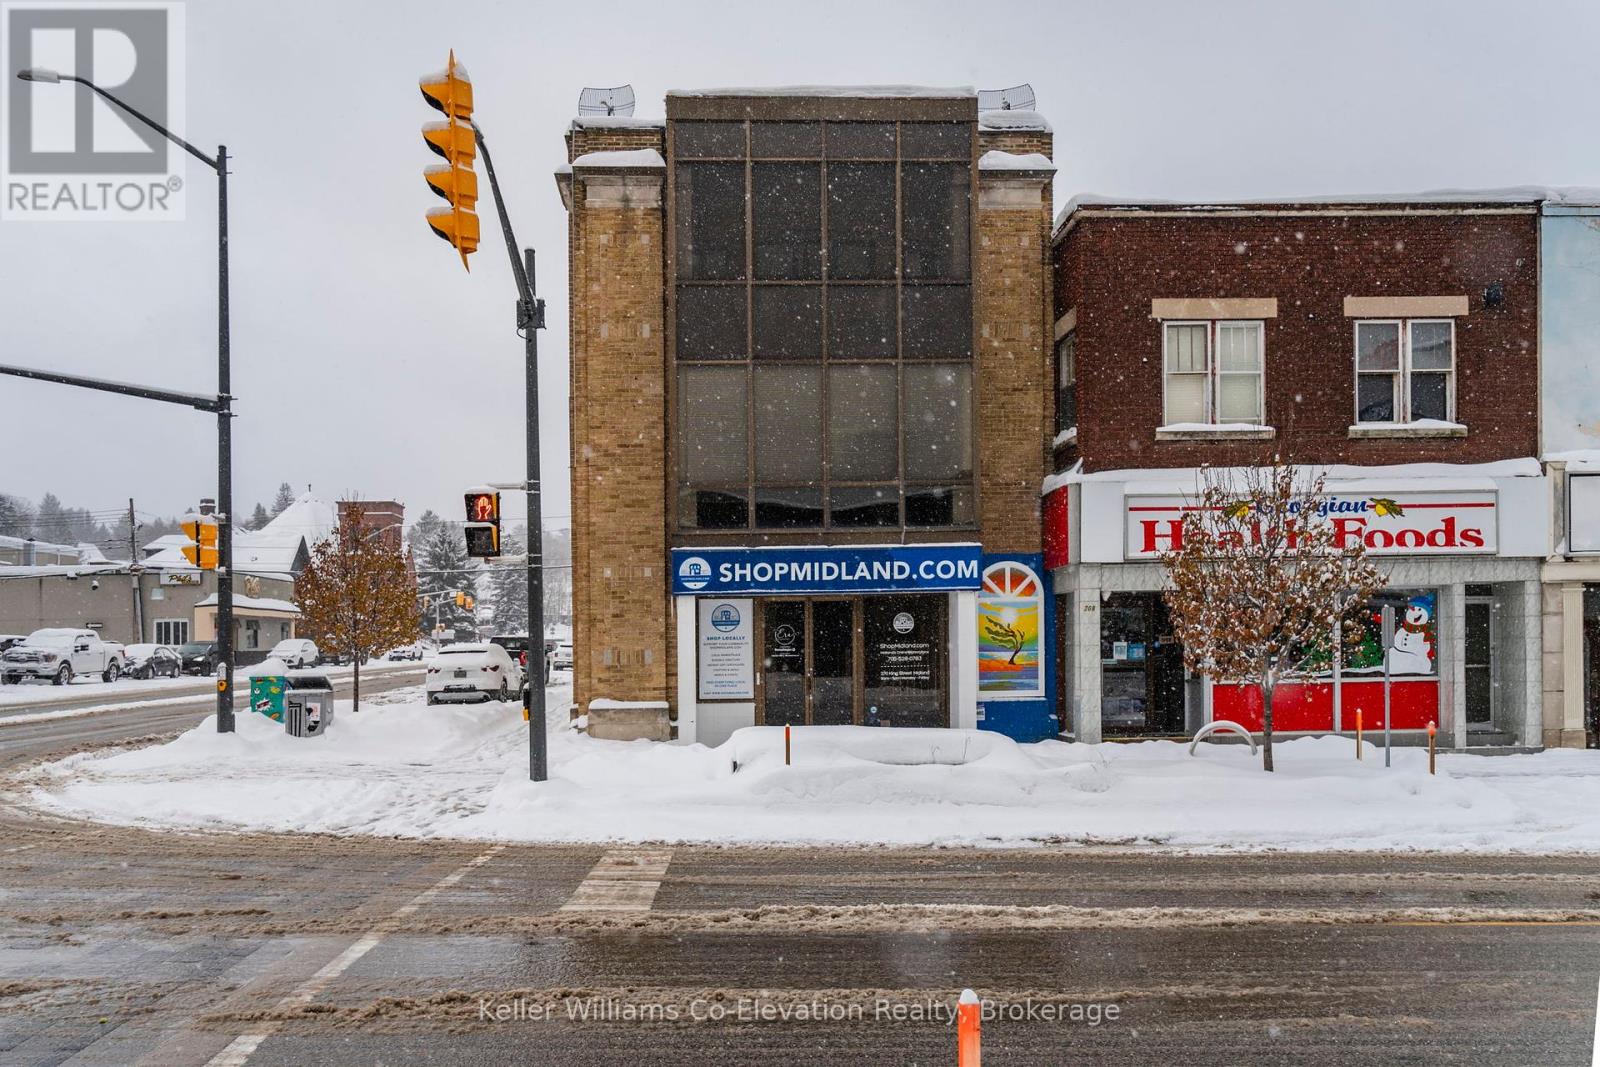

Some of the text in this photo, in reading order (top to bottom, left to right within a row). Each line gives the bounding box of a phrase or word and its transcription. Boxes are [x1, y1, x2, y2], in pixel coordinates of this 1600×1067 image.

[1257, 497, 1367, 517] ogian
[1330, 516, 1485, 548] Foods
[719, 560, 979, 582] SHOPMIDLAND.COM
